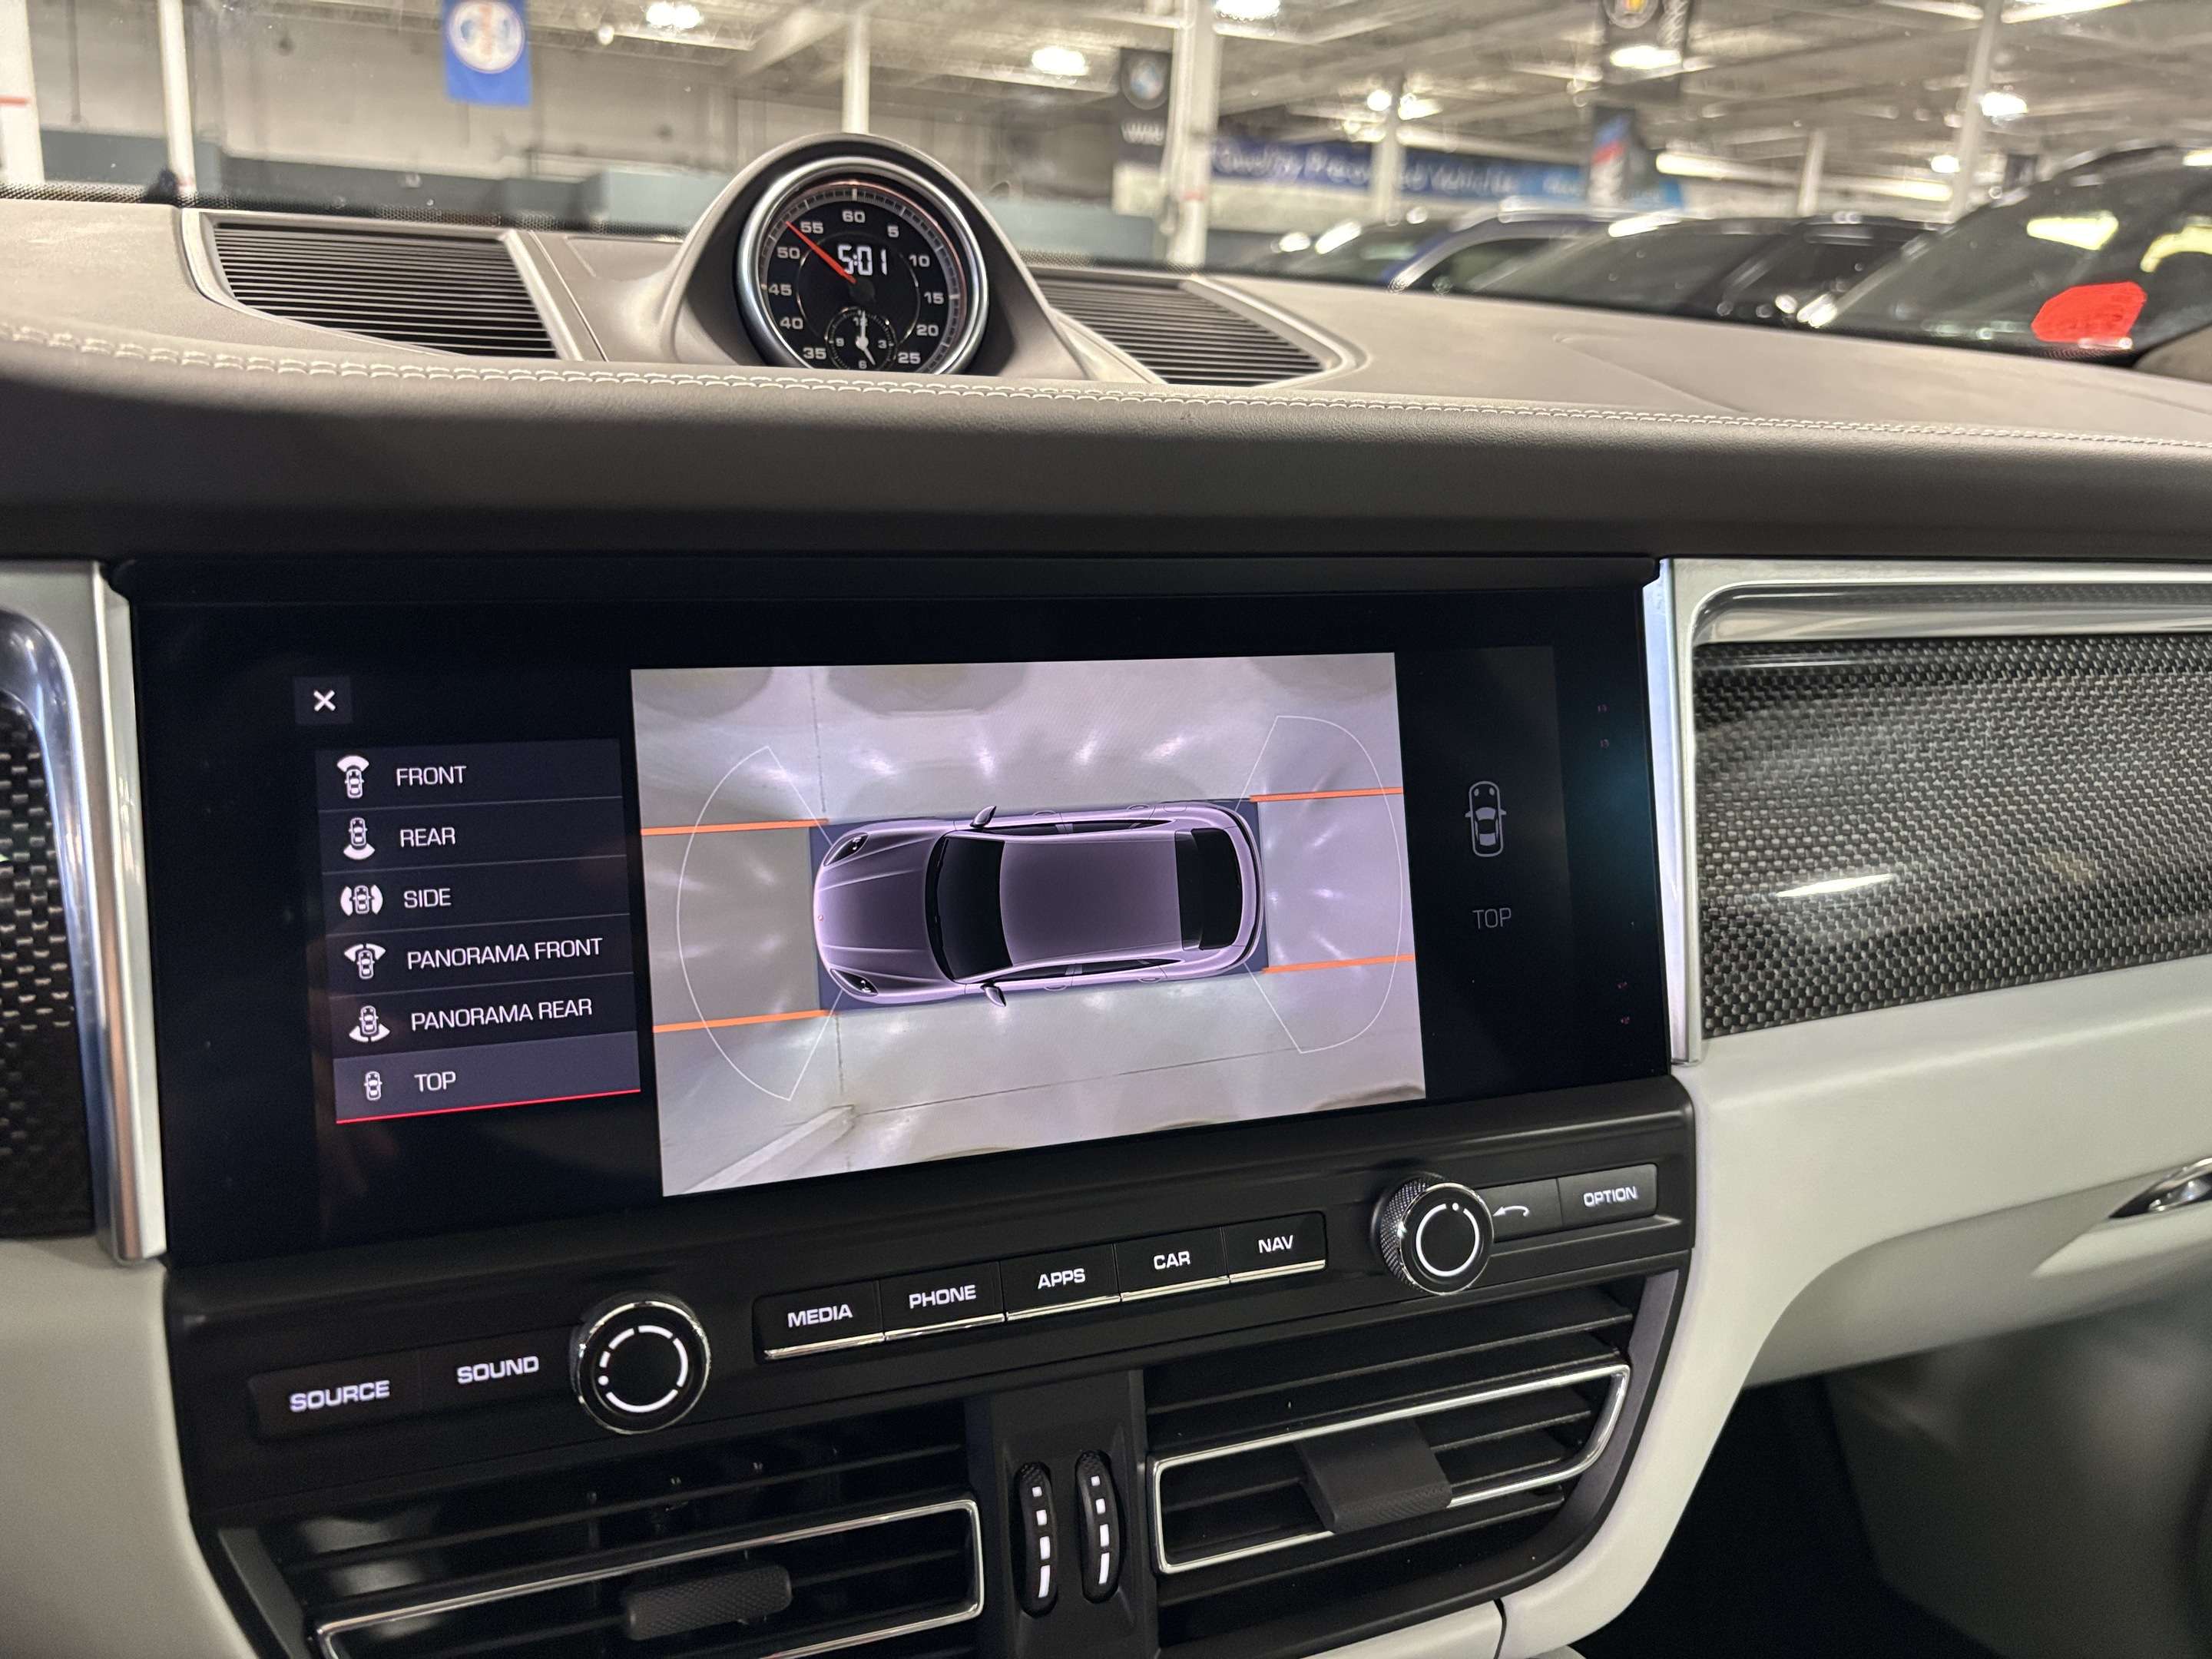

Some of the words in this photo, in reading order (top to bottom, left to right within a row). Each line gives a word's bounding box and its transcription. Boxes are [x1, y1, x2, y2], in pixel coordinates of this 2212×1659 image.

[843, 210, 865, 223] 60
[800, 221, 823, 233] 55
[888, 226, 899, 237] 5
[777, 247, 800, 259] 50
[838, 244, 887, 276] 5:01
[909, 255, 929, 267] 10
[769, 284, 792, 296] 45
[924, 292, 944, 304] 15
[780, 319, 803, 330] 40
[916, 324, 939, 336] 20
[803, 348, 826, 359] 35
[898, 353, 920, 363] 25
[396, 766, 466, 786] FRONT
[400, 827, 455, 847] REAR
[404, 889, 451, 908] SIDE
[1472, 908, 1511, 929] TOP
[408, 944, 529, 969] PANORAMA
[535, 938, 602, 959] FRONT
[412, 1004, 533, 1031] PANORAMA
[538, 998, 591, 1019] REAR
[415, 1071, 455, 1091] TOP
[1584, 1186, 1637, 1207] OPTION
[1259, 1235, 1293, 1253] NAV
[1154, 1251, 1190, 1270] CAR
[1038, 1268, 1085, 1289] APPS
[909, 1285, 976, 1309] PHONE
[788, 1304, 853, 1327] MEDIA
[457, 1356, 538, 1383] SOUND
[290, 1380, 389, 1412] SOURCE
